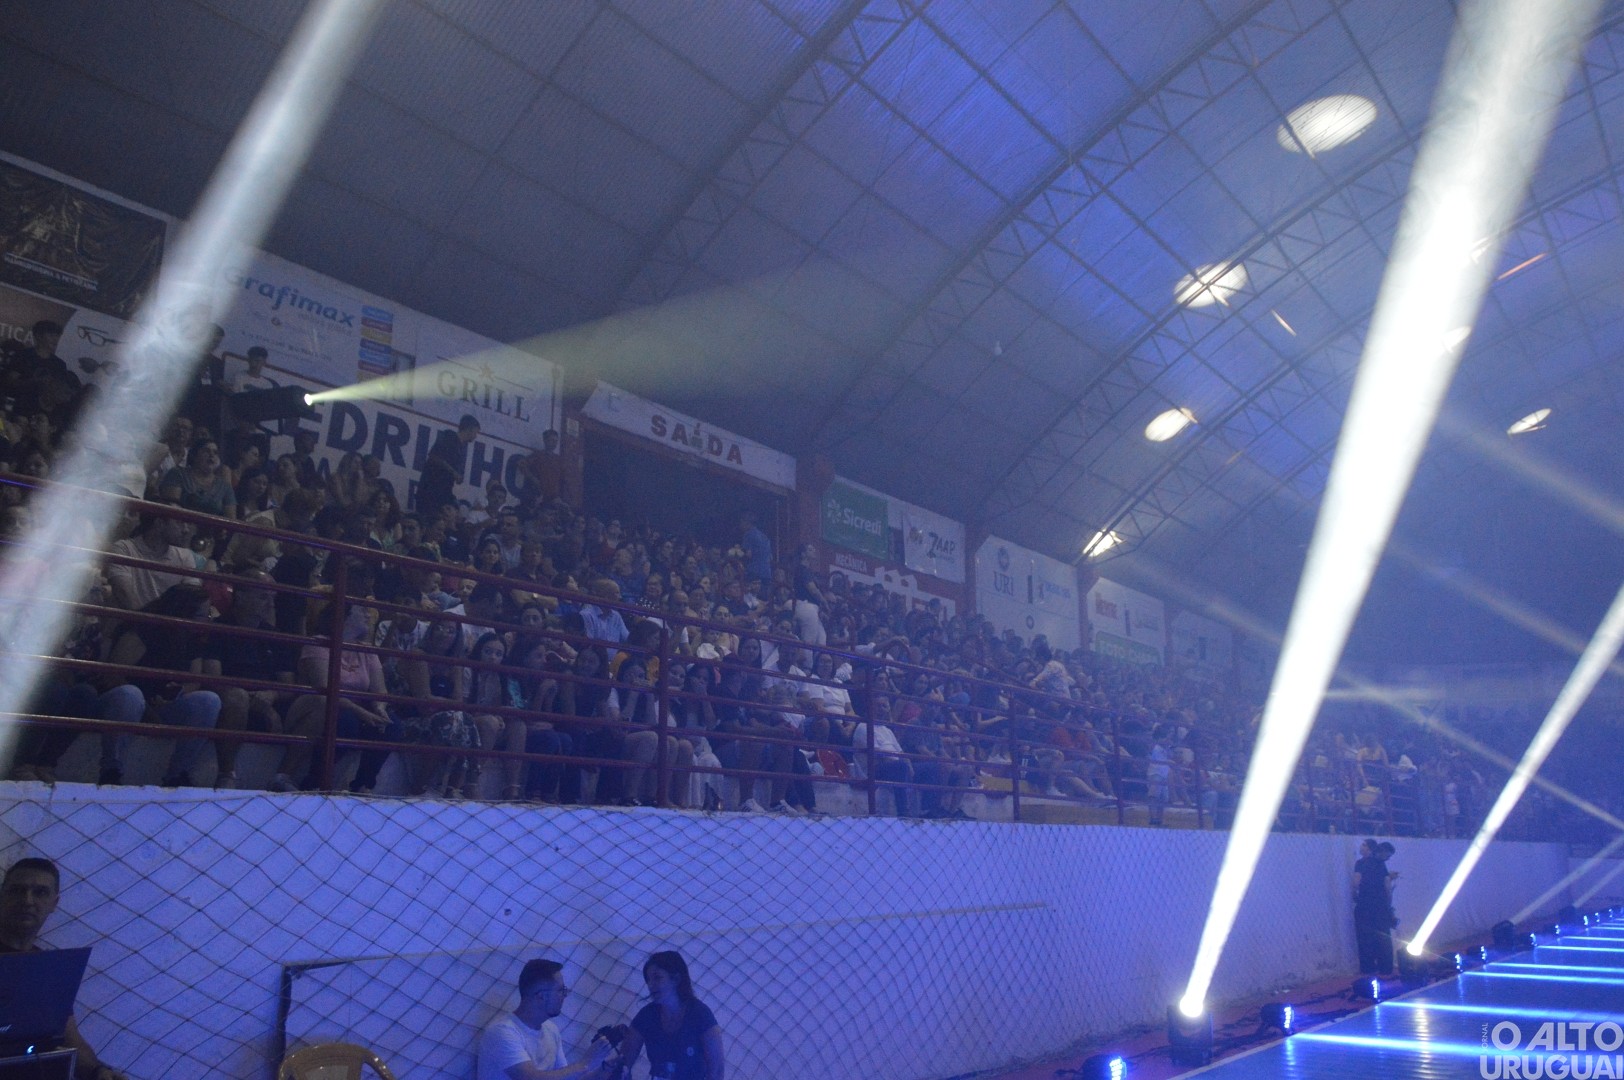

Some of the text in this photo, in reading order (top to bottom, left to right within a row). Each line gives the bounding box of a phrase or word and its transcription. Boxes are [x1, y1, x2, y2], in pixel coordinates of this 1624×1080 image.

[437, 369, 530, 423] GRILL
[843, 508, 882, 536] Sicredi
[993, 571, 1014, 597] URI
